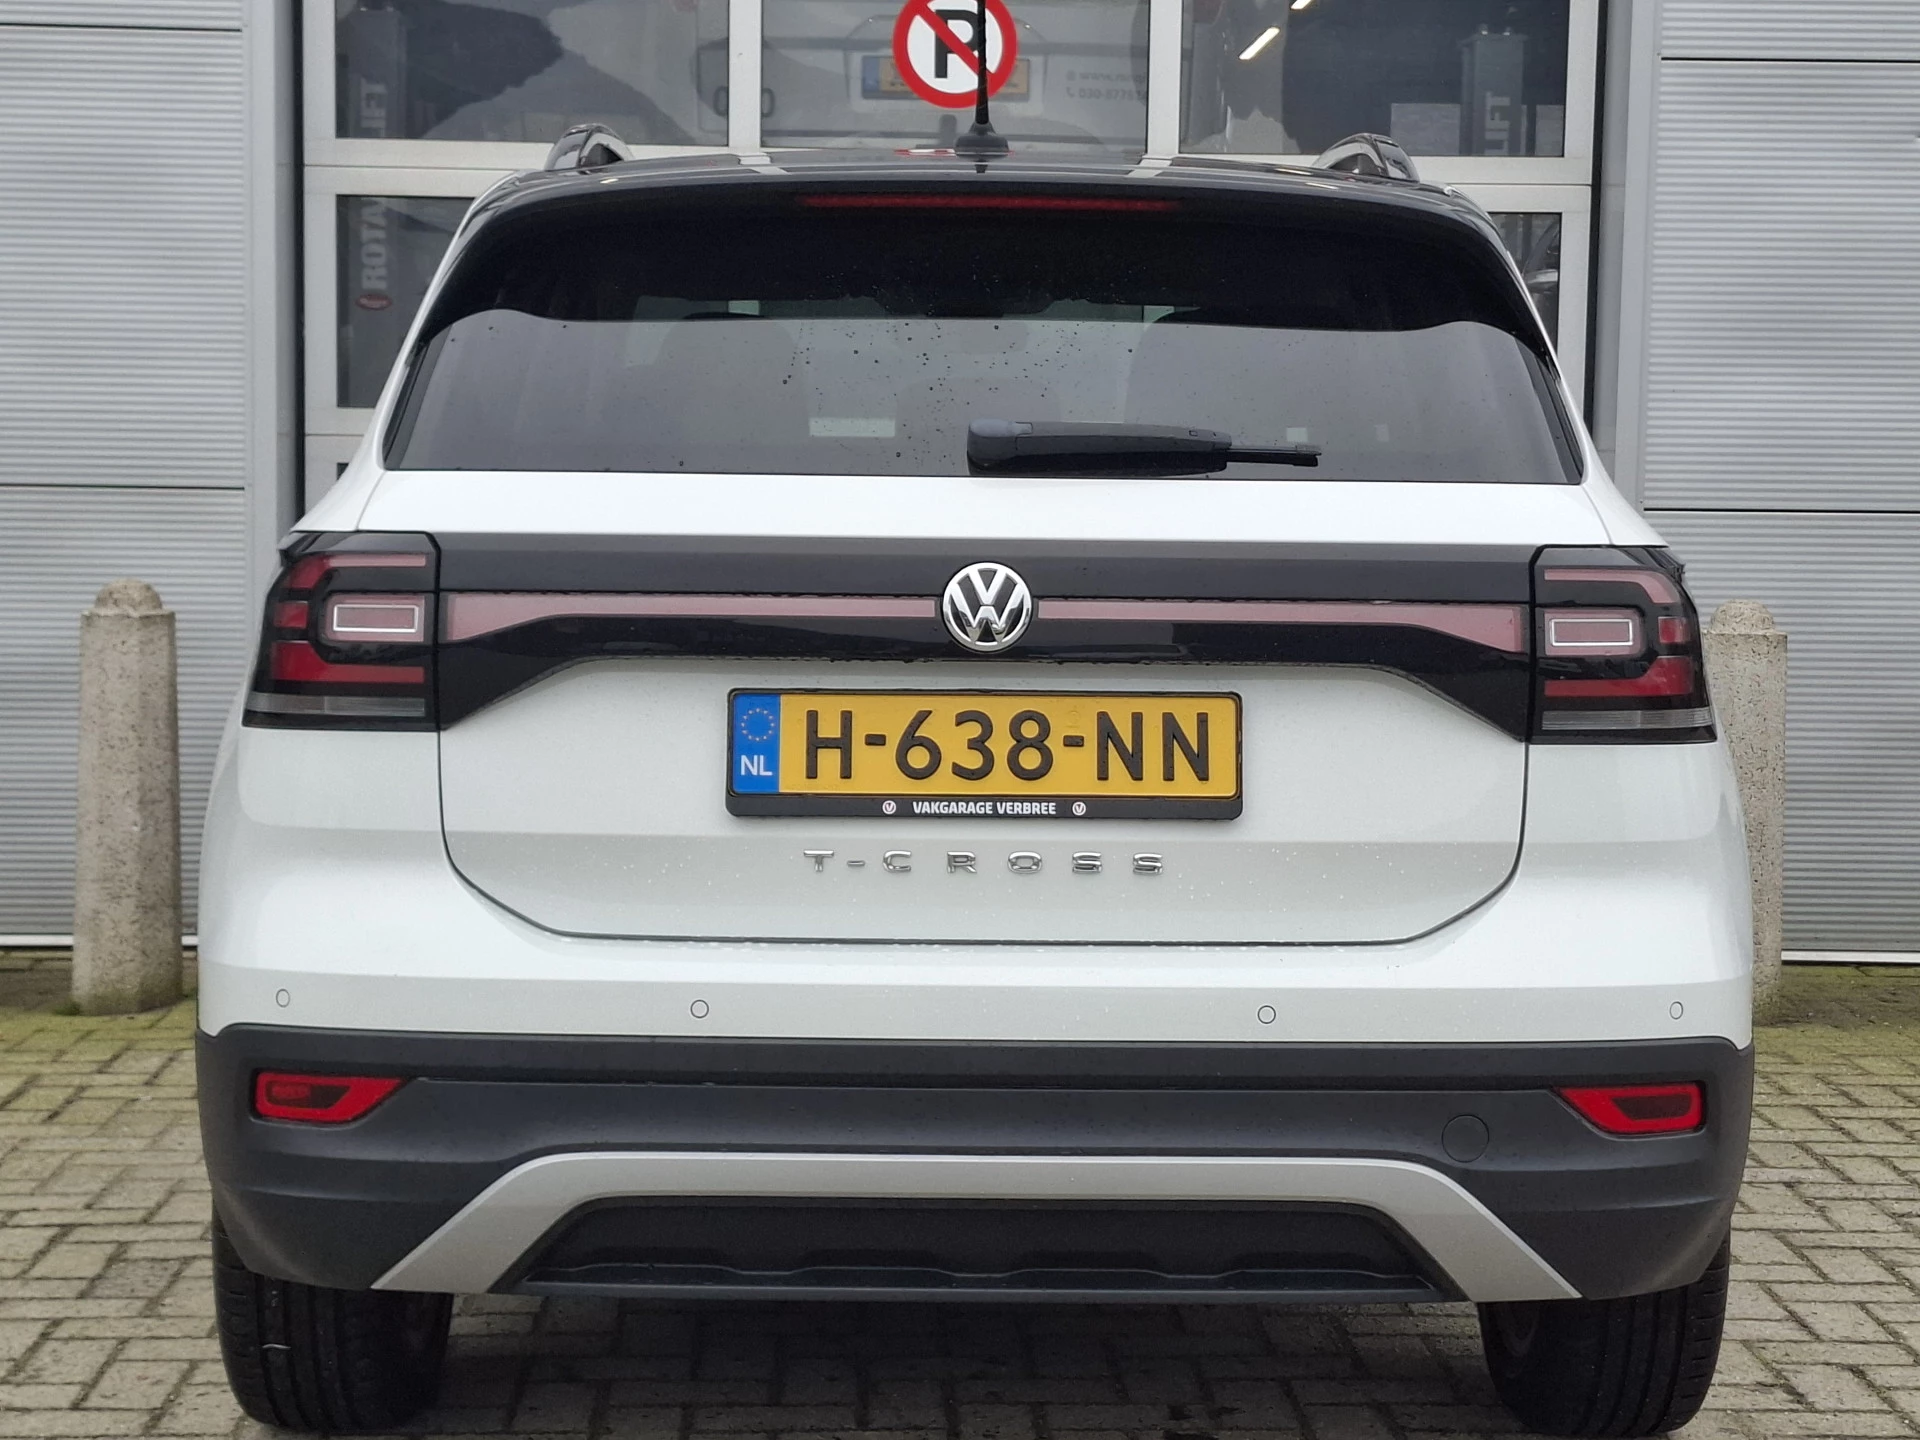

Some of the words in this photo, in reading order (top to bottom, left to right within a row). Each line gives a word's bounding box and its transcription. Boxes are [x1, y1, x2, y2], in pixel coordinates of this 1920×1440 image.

[360, 77, 387, 137] IFT
[1484, 91, 1511, 155] LIFT
[361, 198, 387, 288] ROTA
[741, 754, 773, 777] NL
[804, 709, 1209, 782] H-638-NN
[912, 801, 993, 815] VAKGARAGE
[996, 802, 1056, 815] VERBREE
[803, 849, 1164, 874] T-CROSS
